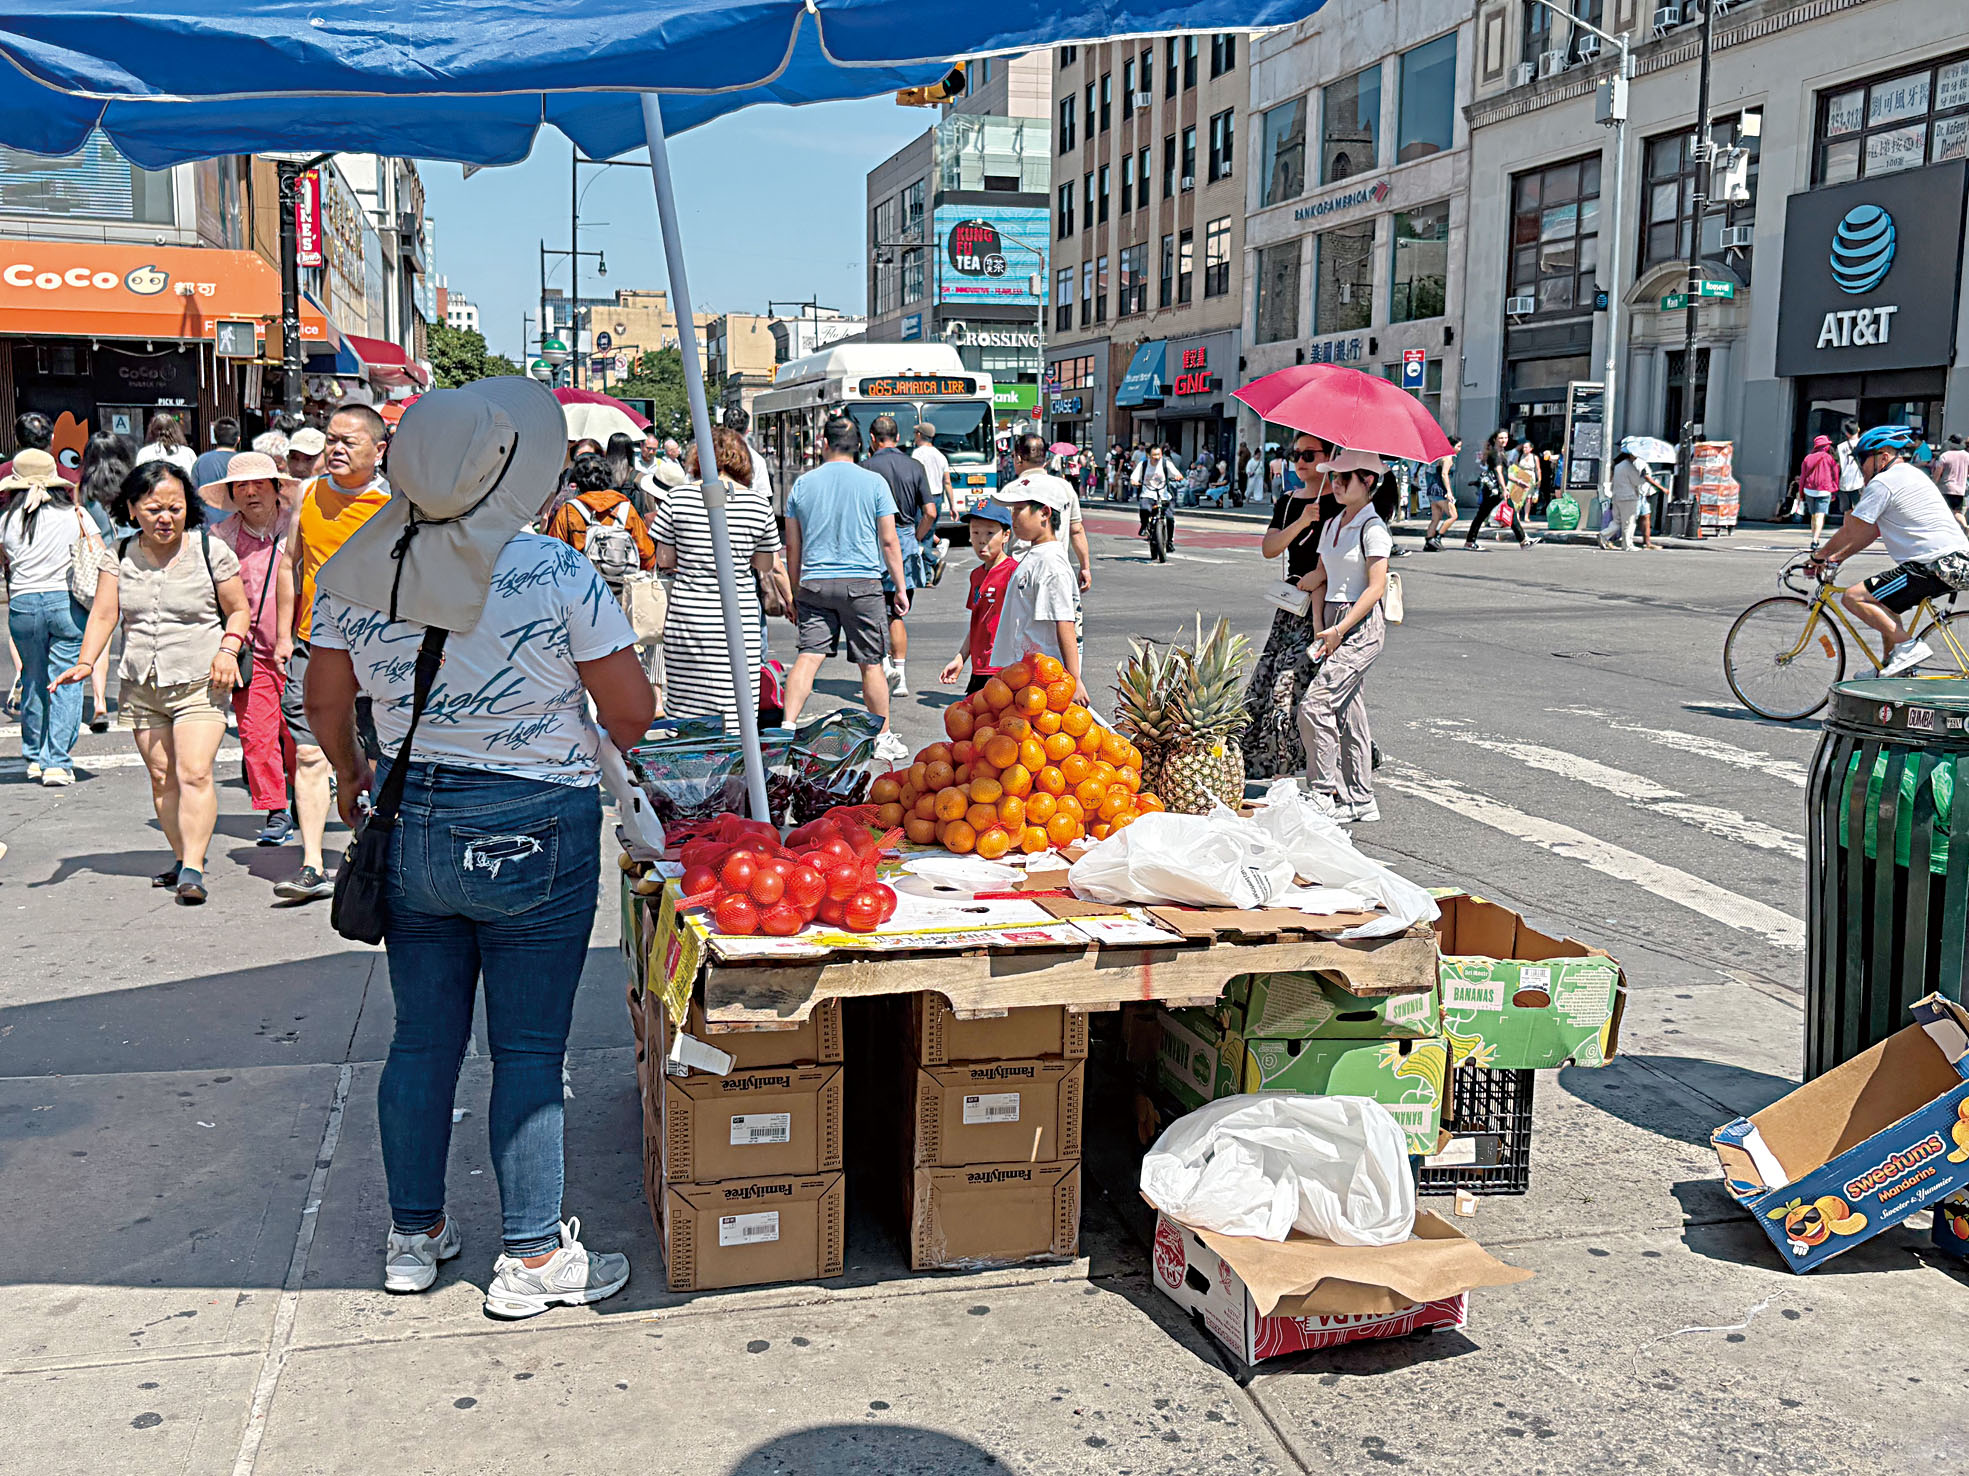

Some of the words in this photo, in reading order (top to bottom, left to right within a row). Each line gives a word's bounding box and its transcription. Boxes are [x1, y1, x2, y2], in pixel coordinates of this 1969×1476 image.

[1940, 134, 1967, 159] Dentist
[1294, 203, 1317, 221] BANK
[1328, 188, 1370, 212] AMERICA
[956, 227, 993, 242] KUNG
[956, 242, 973, 255] FU
[956, 256, 981, 270] TEA
[4, 264, 119, 290] CoCo
[1816, 306, 1898, 349] AT&T
[868, 379, 893, 397] Q65
[894, 380, 937, 395] JAMAICA
[941, 380, 965, 394] LIRR
[1174, 371, 1213, 395] GNC
[158, 398, 174, 406] PICK
[175, 398, 185, 406] UP
[994, 390, 1019, 403] ank
[1051, 399, 1072, 414] CHASE
[115, 416, 127, 429] A
[483, 713, 564, 751] Flight
[1453, 987, 1494, 1003] BANANAS
[1393, 997, 1424, 1019] BANANAS
[969, 1065, 1035, 1080] FamilyTree
[722, 1075, 791, 1090] FamilyTree
[1846, 1135, 1944, 1199] sweetums
[965, 1168, 1032, 1183] FamilyTree
[722, 1183, 793, 1199] FamilyTree
[1877, 1166, 1937, 1203] Mandarins
[1880, 1199, 1910, 1220] Sweeter
[1916, 1176, 1954, 1202] Yummier
